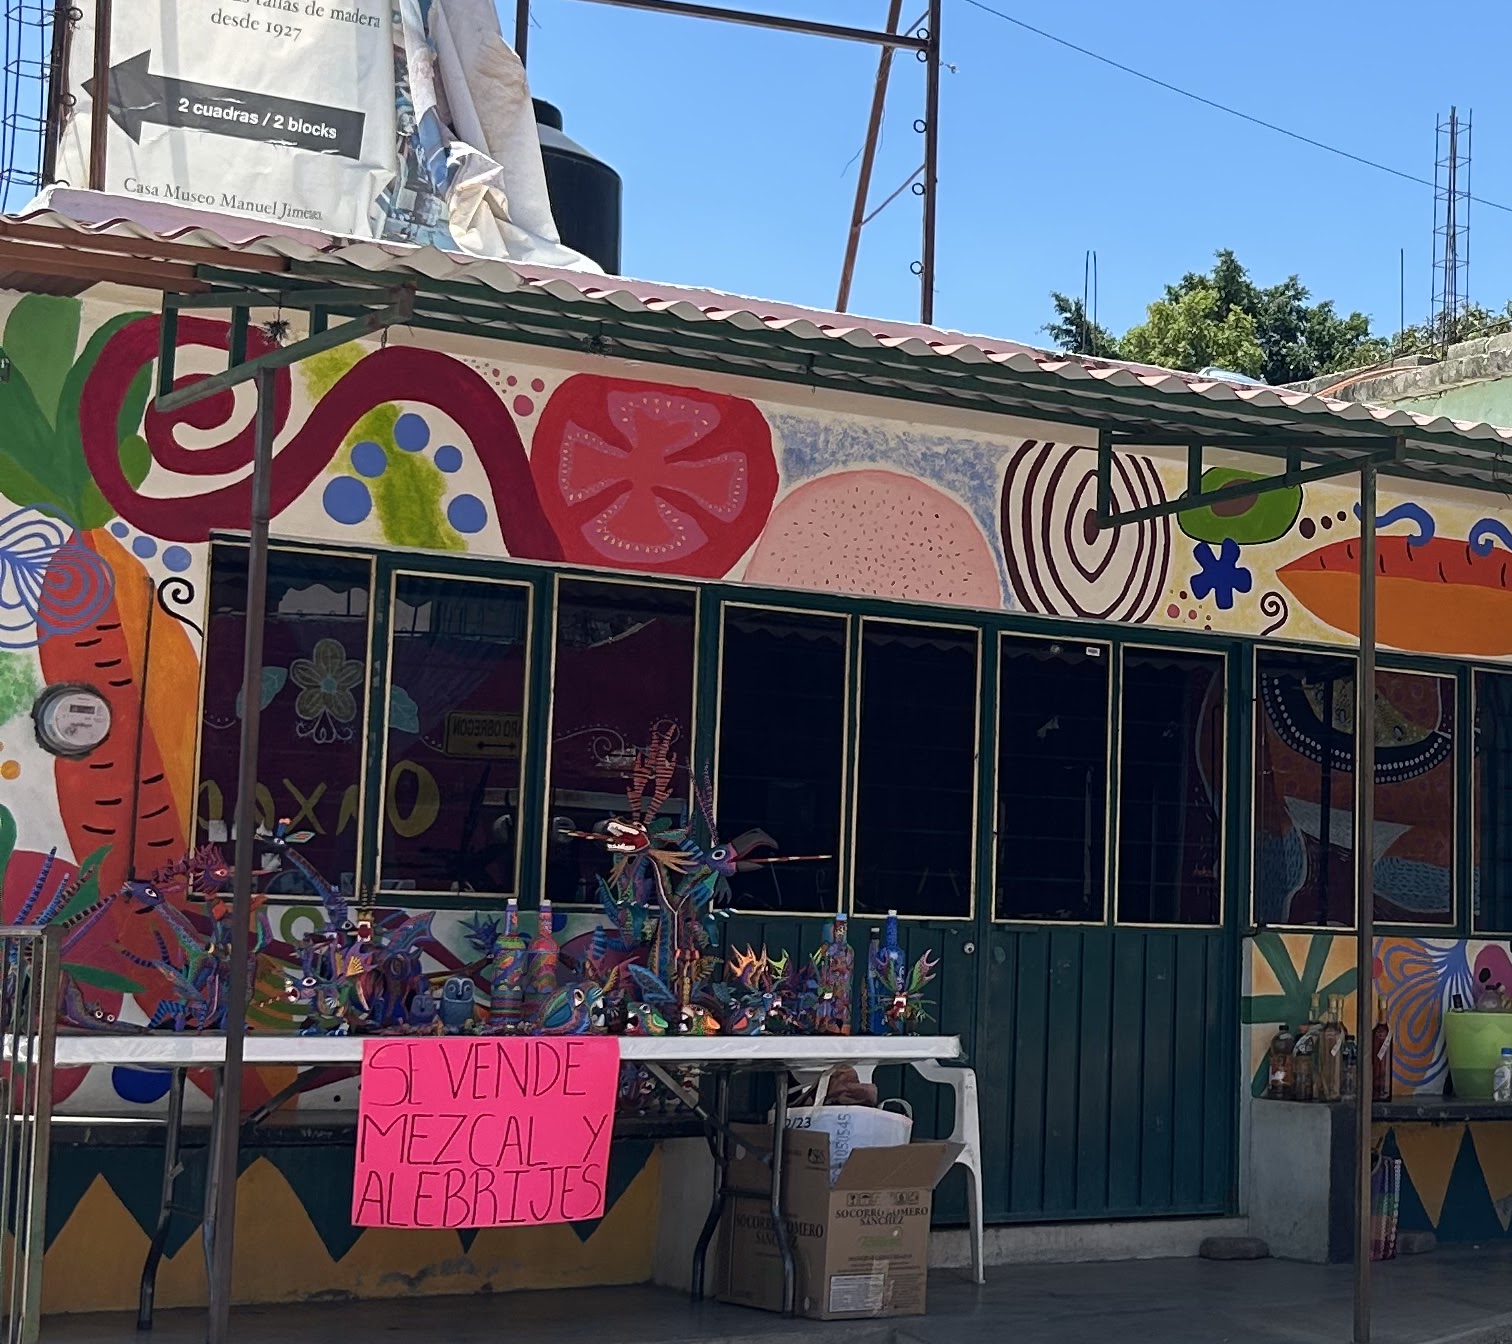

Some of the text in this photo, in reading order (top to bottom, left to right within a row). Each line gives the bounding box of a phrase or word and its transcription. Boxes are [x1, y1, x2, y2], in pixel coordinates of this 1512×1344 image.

[211, 8, 302, 42] desde 1927
[304, 0, 325, 17] de
[330, 8, 380, 28] madera
[178, 97, 337, 140] 2 cuadras / 2 blocks
[124, 177, 159, 197] Casa
[163, 183, 215, 206] Museo
[220, 193, 277, 216] Manuel
[368, 1041, 586, 1106] SE VENDE
[360, 1112, 609, 1167] MEZCAL Y
[355, 1163, 602, 1227] ALEBRIJES
[784, 1219, 824, 1238] OMERO
